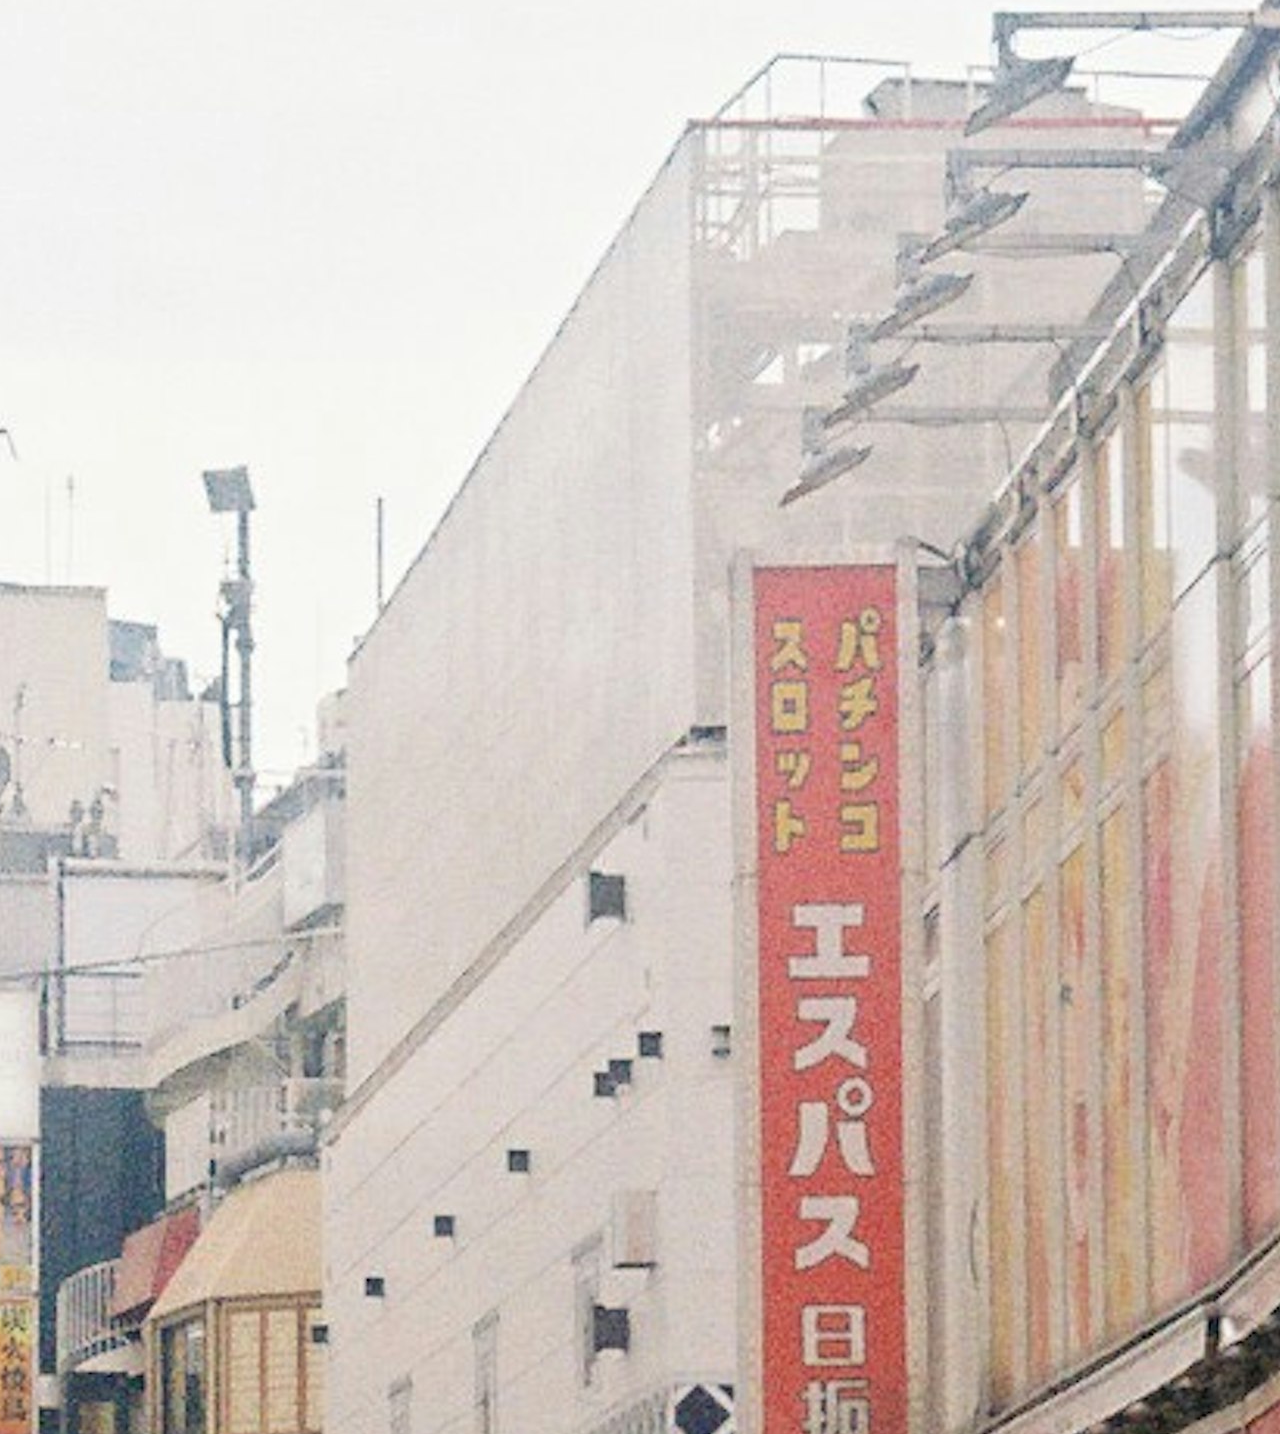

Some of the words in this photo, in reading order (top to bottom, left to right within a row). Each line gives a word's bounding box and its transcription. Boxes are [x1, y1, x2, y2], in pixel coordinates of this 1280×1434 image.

[770, 618, 812, 856] スロット
[833, 604, 883, 855] パチンコ
[786, 903, 875, 1270] エスパス
